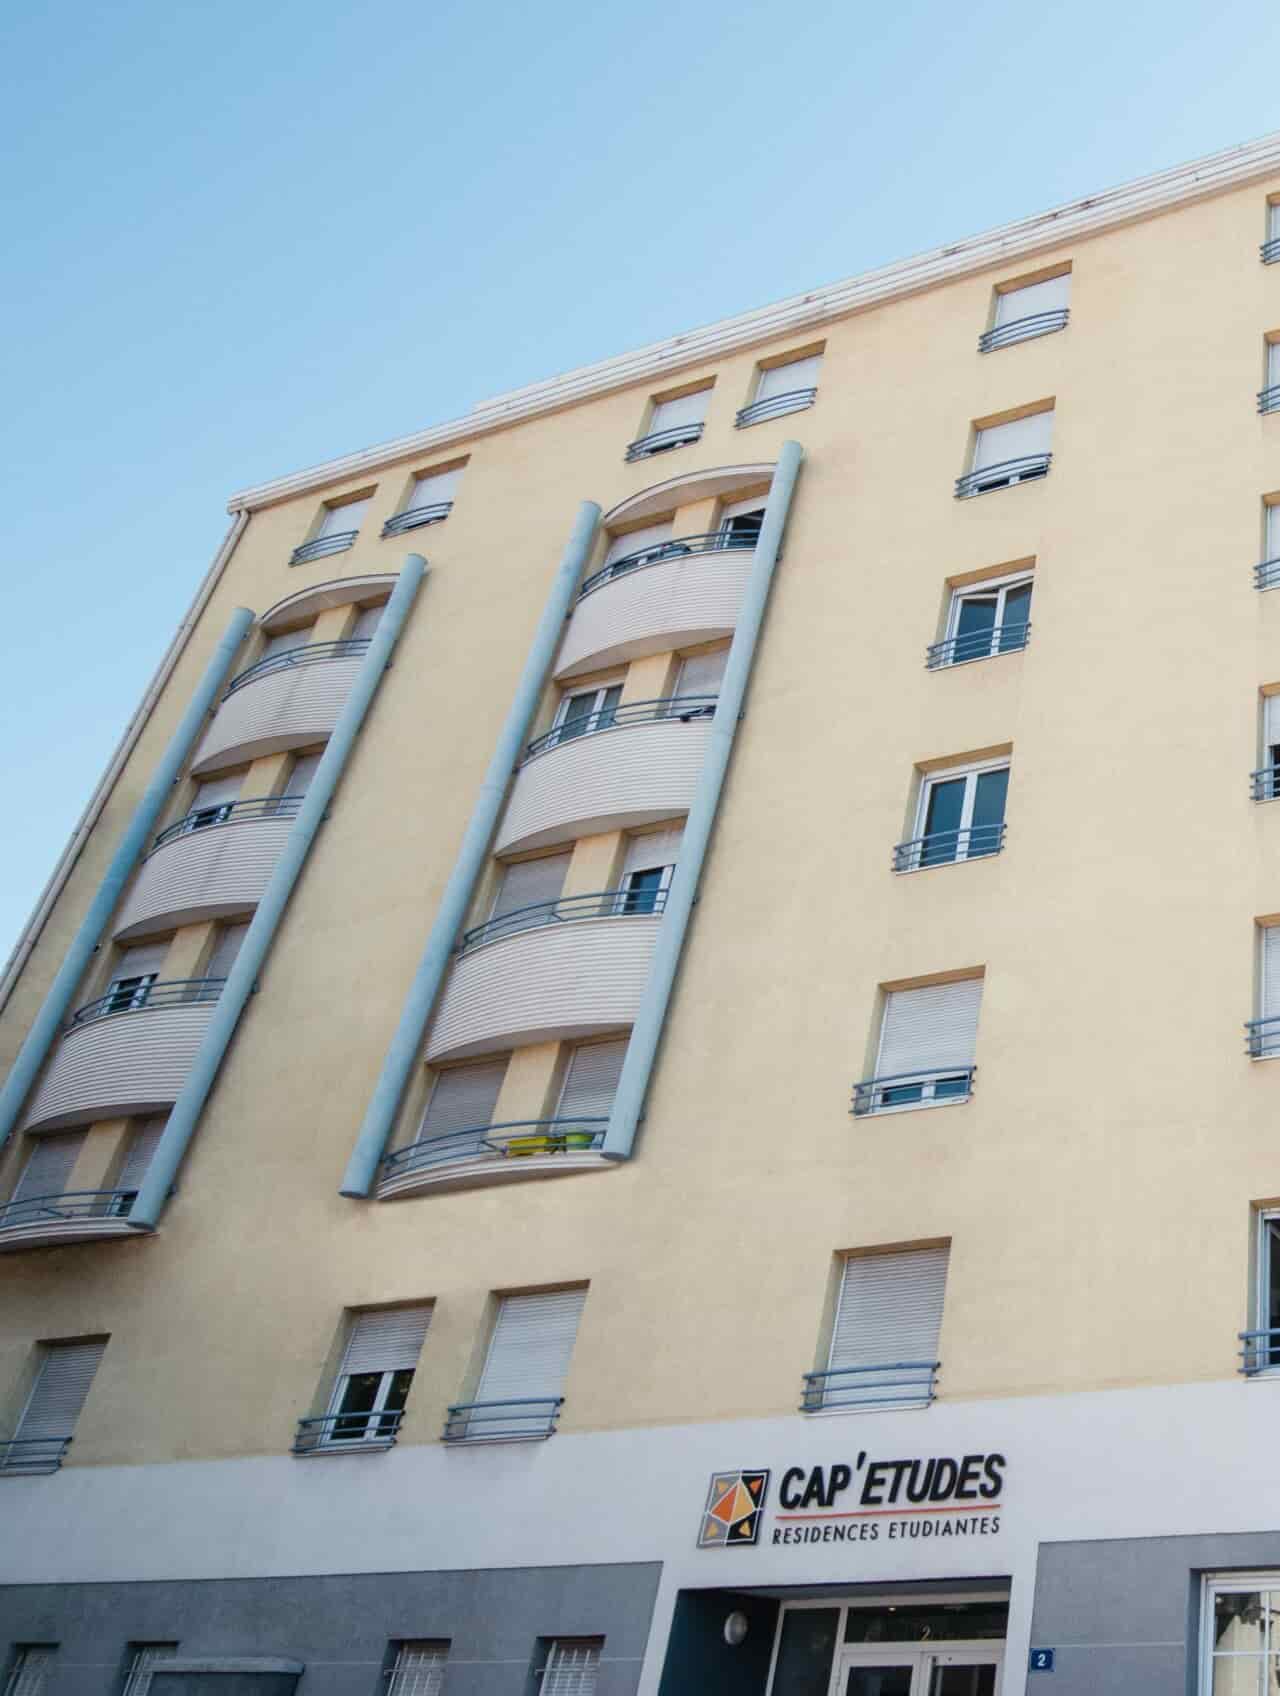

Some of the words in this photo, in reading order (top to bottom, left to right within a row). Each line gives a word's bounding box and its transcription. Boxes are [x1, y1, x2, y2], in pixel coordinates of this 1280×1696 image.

[779, 1451, 1006, 1509] CAP'ETUDES
[772, 1522, 879, 1545] RESIDENCES
[888, 1516, 1001, 1539] ETUDIANTES
[1037, 1653, 1047, 1667] 2
